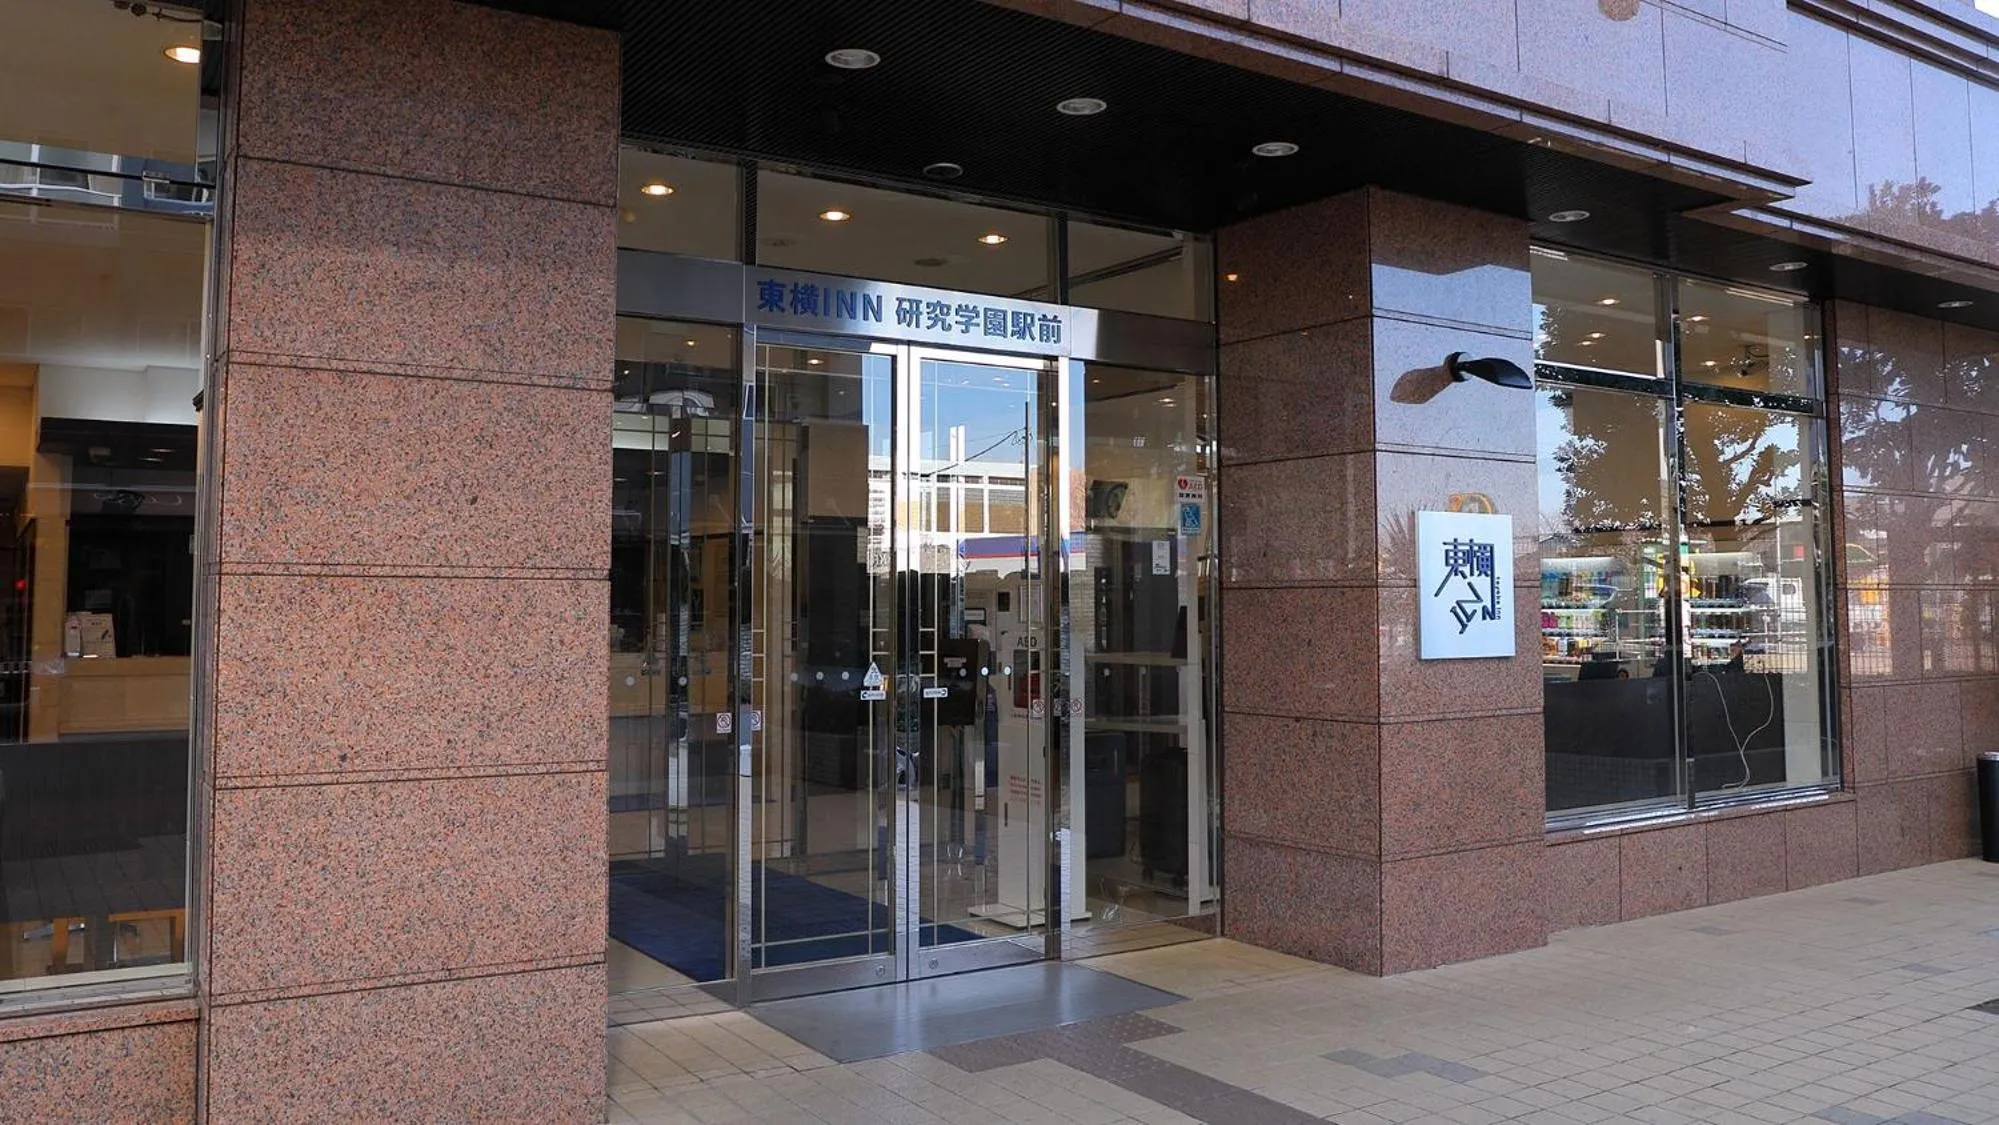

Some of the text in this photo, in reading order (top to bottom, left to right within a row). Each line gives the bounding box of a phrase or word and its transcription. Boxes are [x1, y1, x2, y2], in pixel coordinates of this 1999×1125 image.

[756, 278, 1063, 345] 東横INN 研究学園駅前
